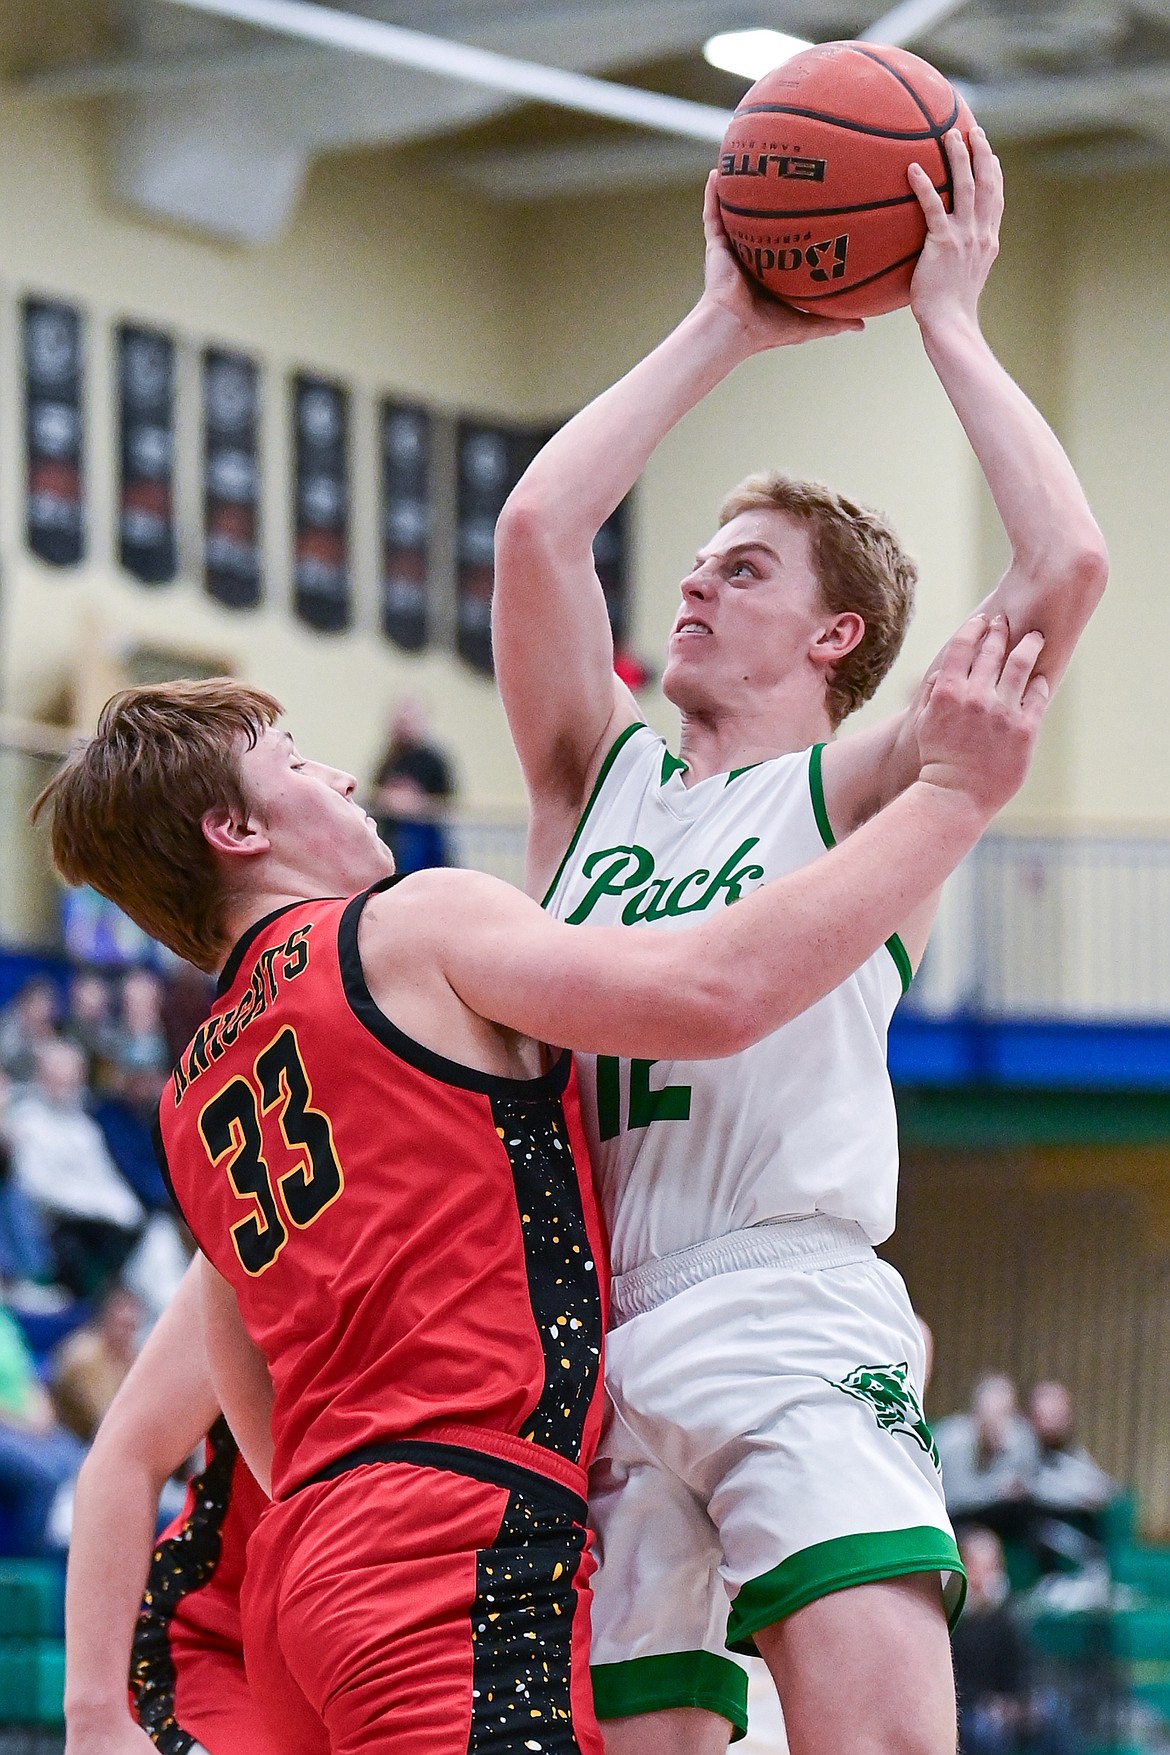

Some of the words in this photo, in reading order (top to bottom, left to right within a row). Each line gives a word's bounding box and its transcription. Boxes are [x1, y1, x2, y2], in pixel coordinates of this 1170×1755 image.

[721, 153, 827, 184] ELITE
[564, 836, 765, 926] Pack
[197, 1023, 345, 1278] 33
